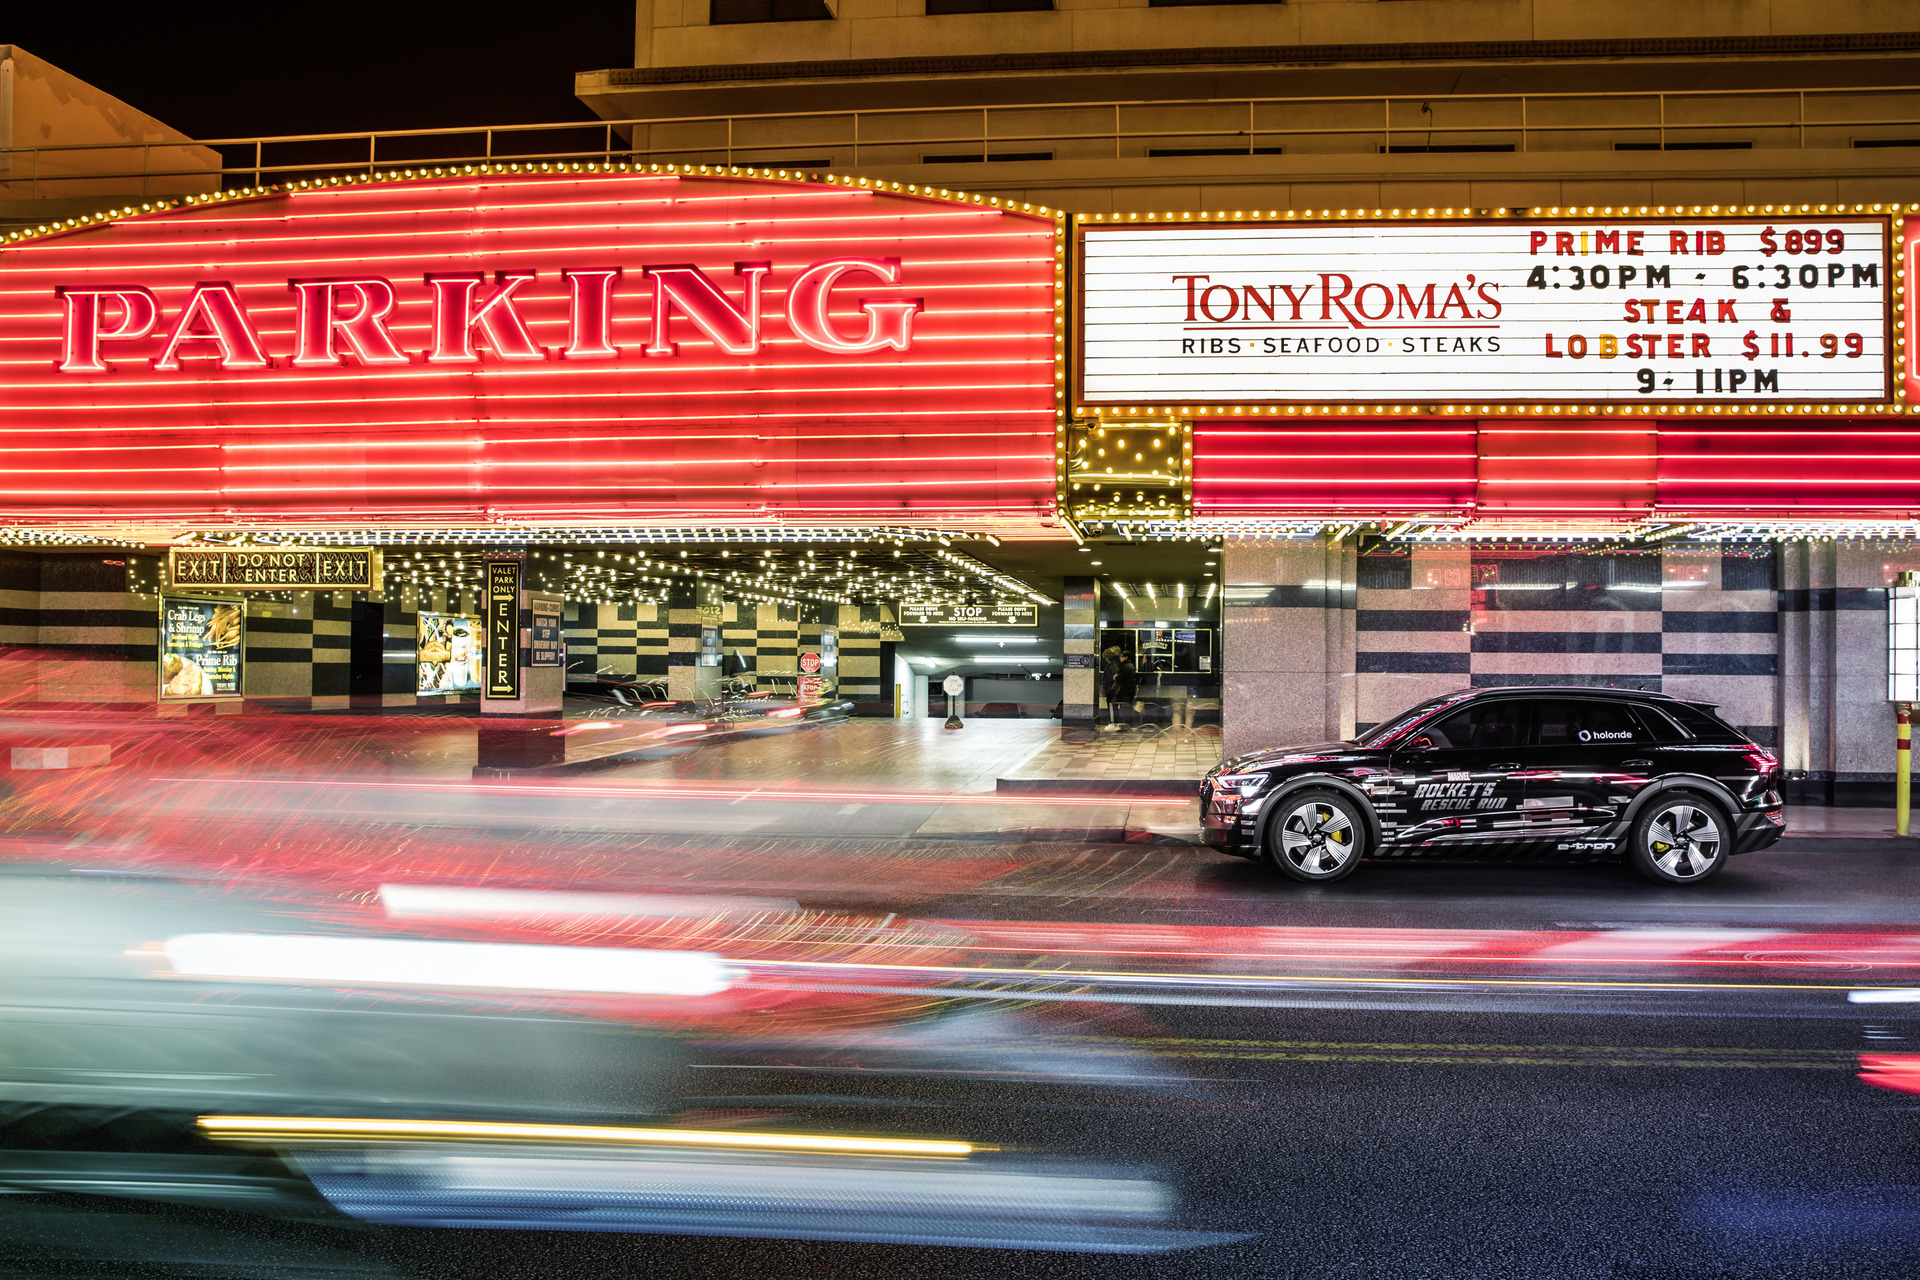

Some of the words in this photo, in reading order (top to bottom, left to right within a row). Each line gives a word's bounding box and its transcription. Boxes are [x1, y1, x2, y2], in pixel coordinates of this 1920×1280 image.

[1529, 229, 1644, 256] PRIME
[1669, 229, 1726, 256] RIB
[1758, 226, 1845, 257] $899
[1526, 264, 1671, 290] 4:30PM
[1732, 263, 1879, 289] 6:30PM
[52, 256, 926, 375] PARKING
[1622, 297, 1738, 324] STEAK
[1770, 297, 1791, 323] &
[1182, 338, 1241, 354] RIBS
[1263, 337, 1380, 353] SEAFOOD
[1402, 336, 1501, 353] STEAKS
[1545, 332, 1712, 360] LOBSTER
[1740, 330, 1864, 361] $11.99
[237, 554, 264, 567] DO
[269, 554, 304, 567] NOT
[177, 560, 220, 576] EXIT
[323, 560, 367, 577] EXIT
[492, 567, 516, 575] VALET
[245, 569, 297, 582] ENTER
[494, 576, 514, 584] PARK
[493, 585, 515, 593] ONLY
[168, 609, 188, 621] Crab
[188, 610, 206, 625] Legs
[953, 607, 983, 617] STOP
[168, 623, 175, 633] &
[176, 622, 205, 636] Shrimp
[496, 603, 510, 684] ENTER
[195, 654, 222, 666] Prime
[222, 654, 238, 666] Rib
[802, 658, 820, 667] STOP
[1593, 731, 1633, 740] holoride
[1447, 771, 1471, 782] MARVEL
[1413, 782, 1498, 799] ROCKET'S
[1420, 798, 1476, 811] RESCUE
[1476, 797, 1508, 810] RUN
[1557, 841, 1616, 851] e-tron
